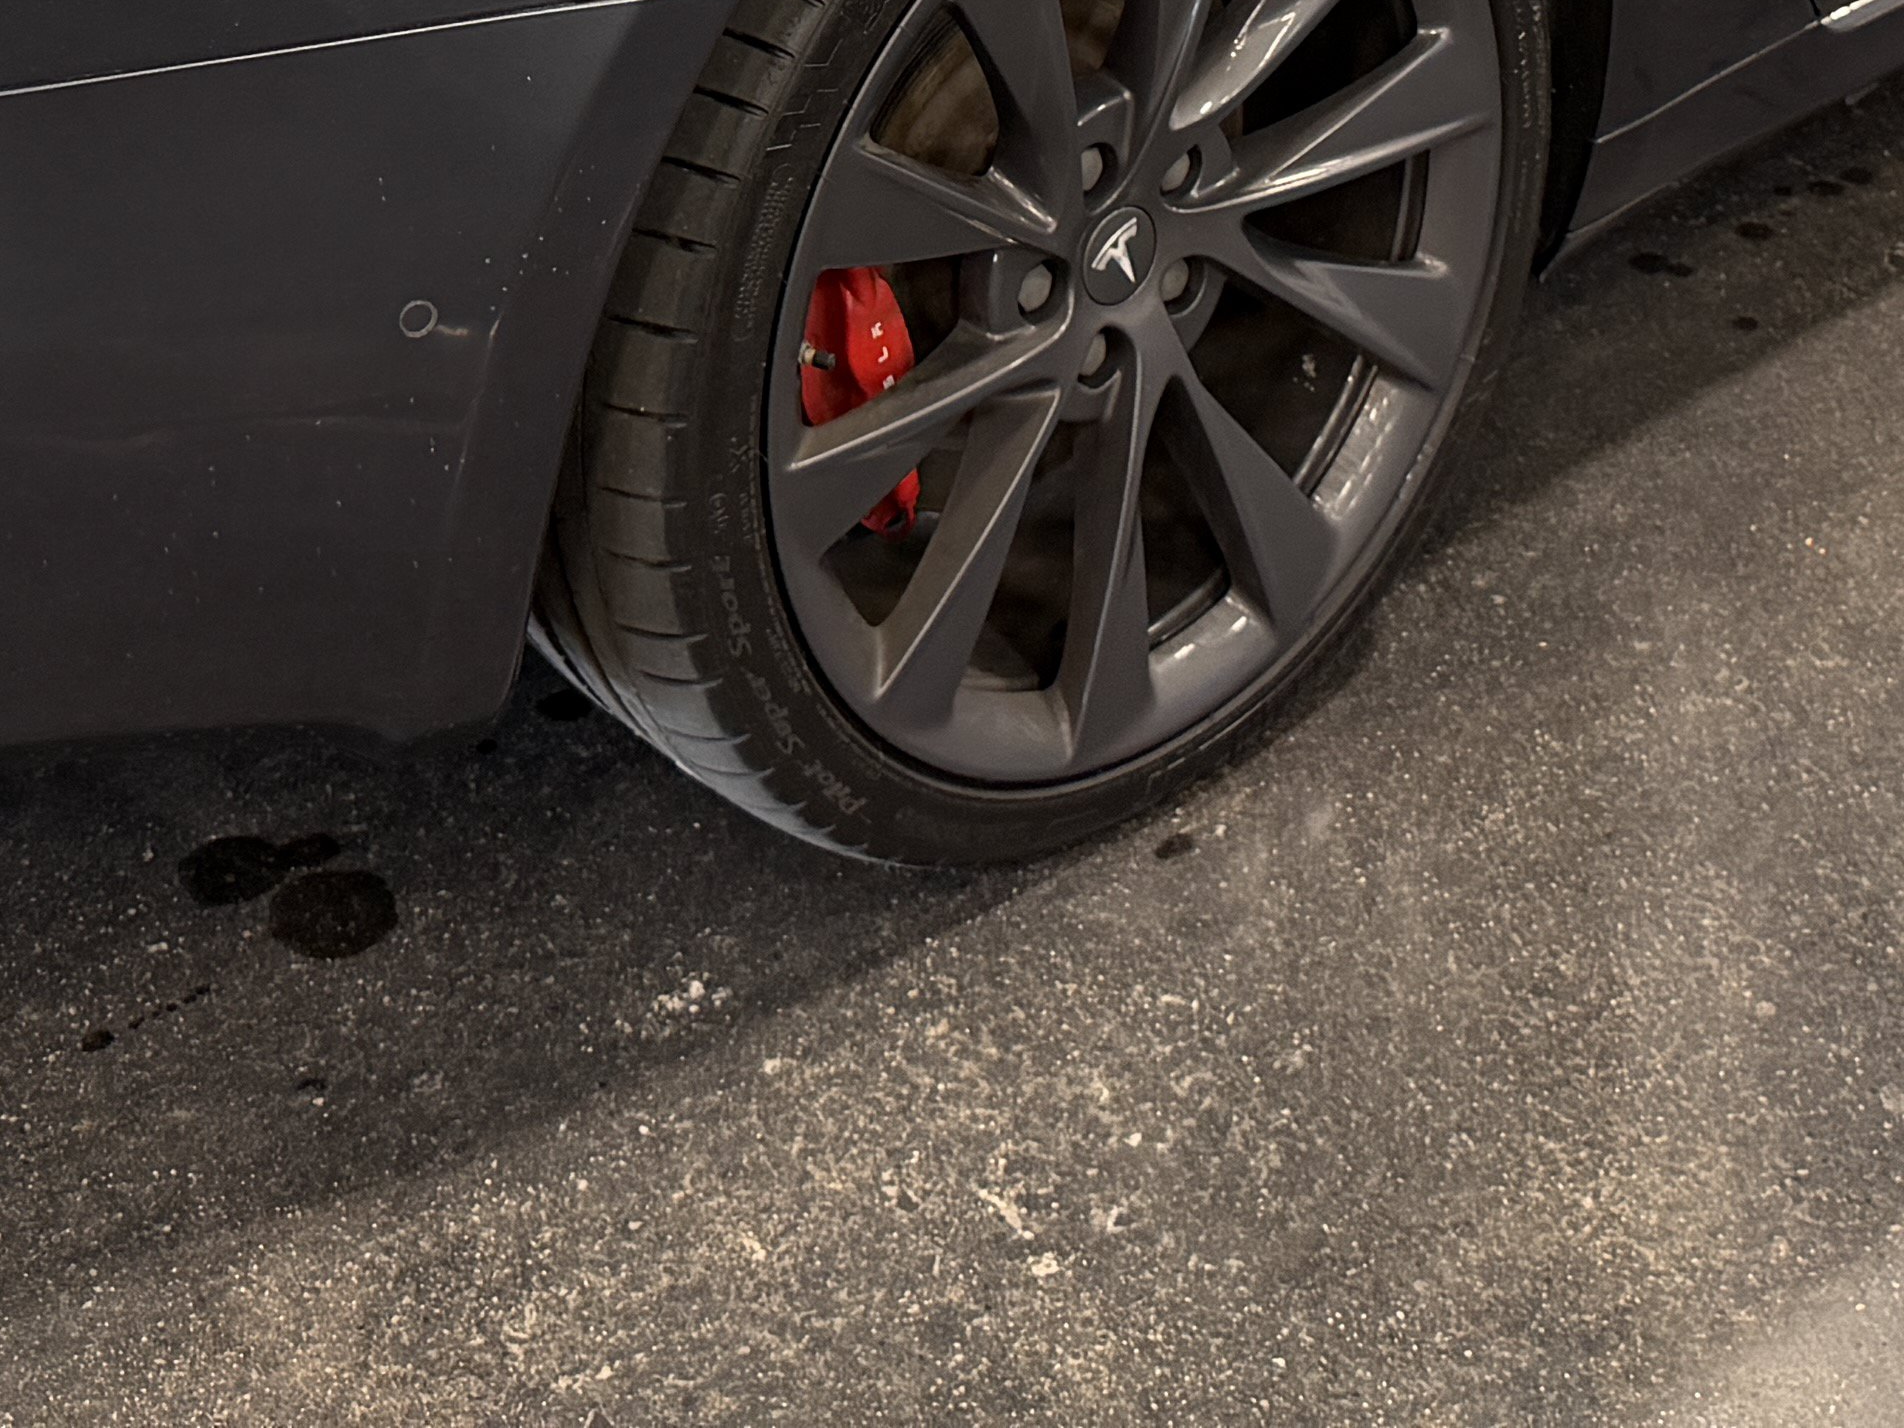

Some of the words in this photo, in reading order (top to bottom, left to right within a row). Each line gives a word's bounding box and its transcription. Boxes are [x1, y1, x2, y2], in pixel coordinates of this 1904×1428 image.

[711, 554, 753, 658] Sport
[744, 674, 805, 756] Super
[804, 760, 870, 818] Pilot
